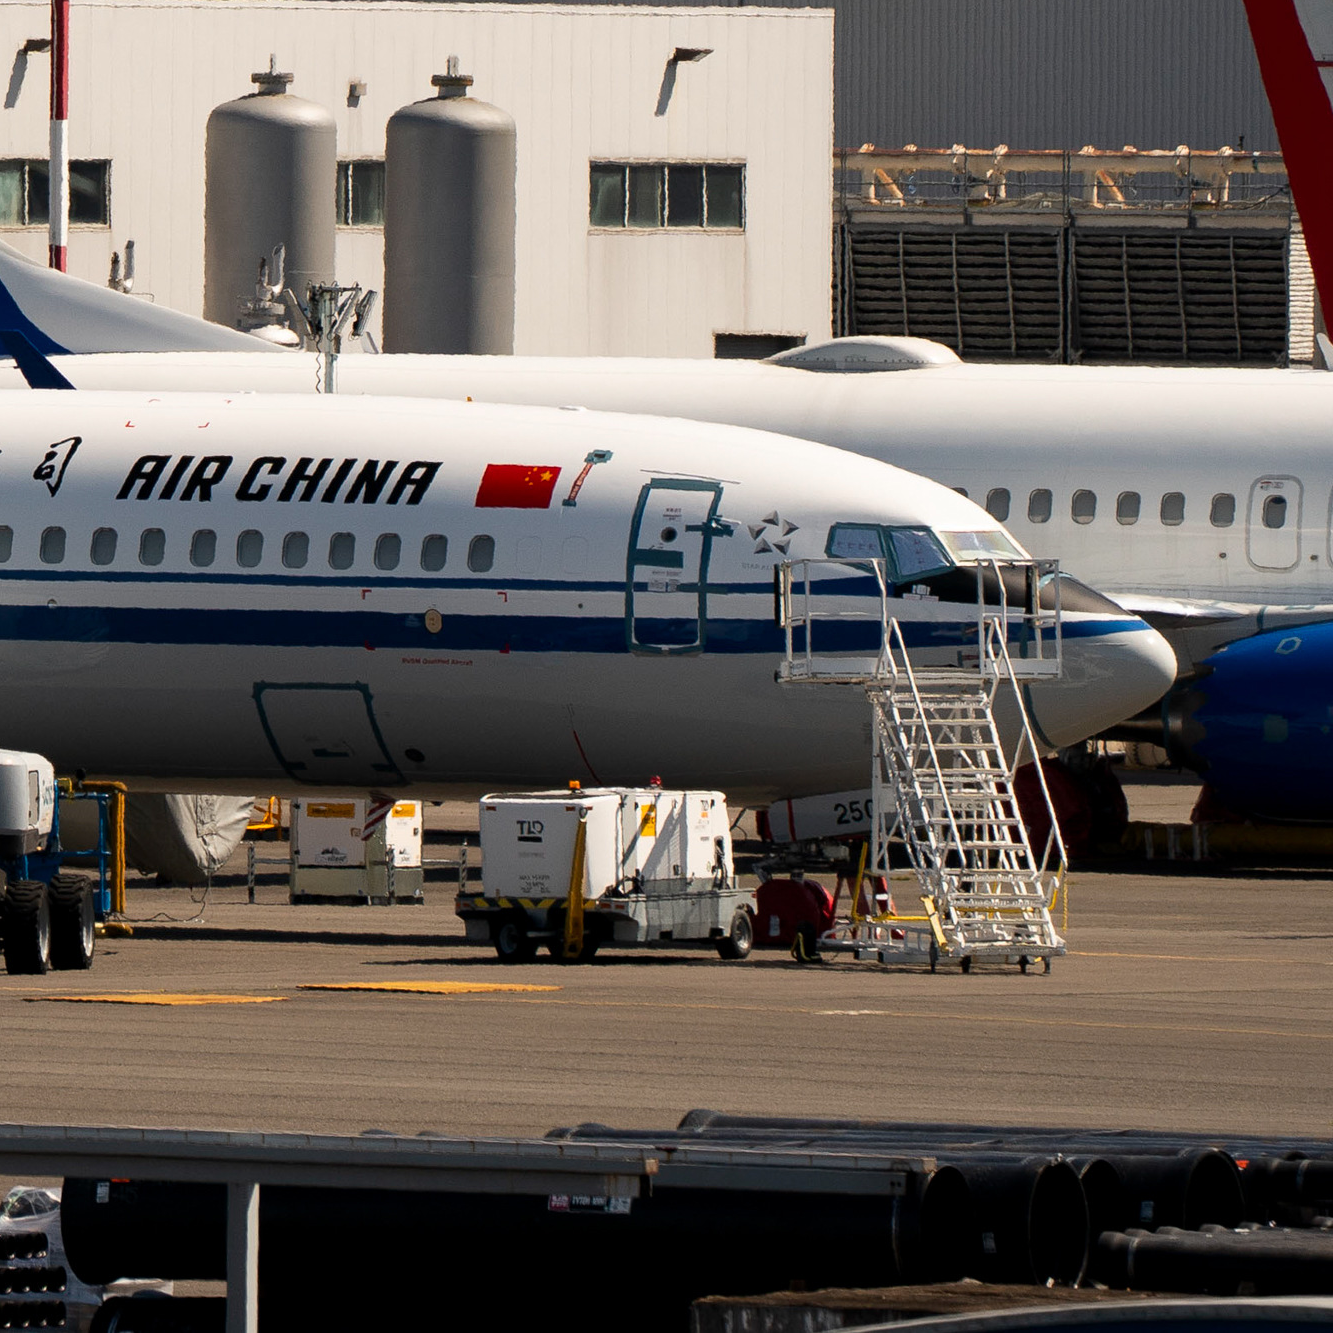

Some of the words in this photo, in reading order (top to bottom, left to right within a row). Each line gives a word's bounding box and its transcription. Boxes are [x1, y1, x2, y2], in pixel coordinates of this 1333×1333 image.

[115, 454, 234, 503] AIR
[234, 456, 444, 506] CHINA
[516, 820, 544, 835] TLD
